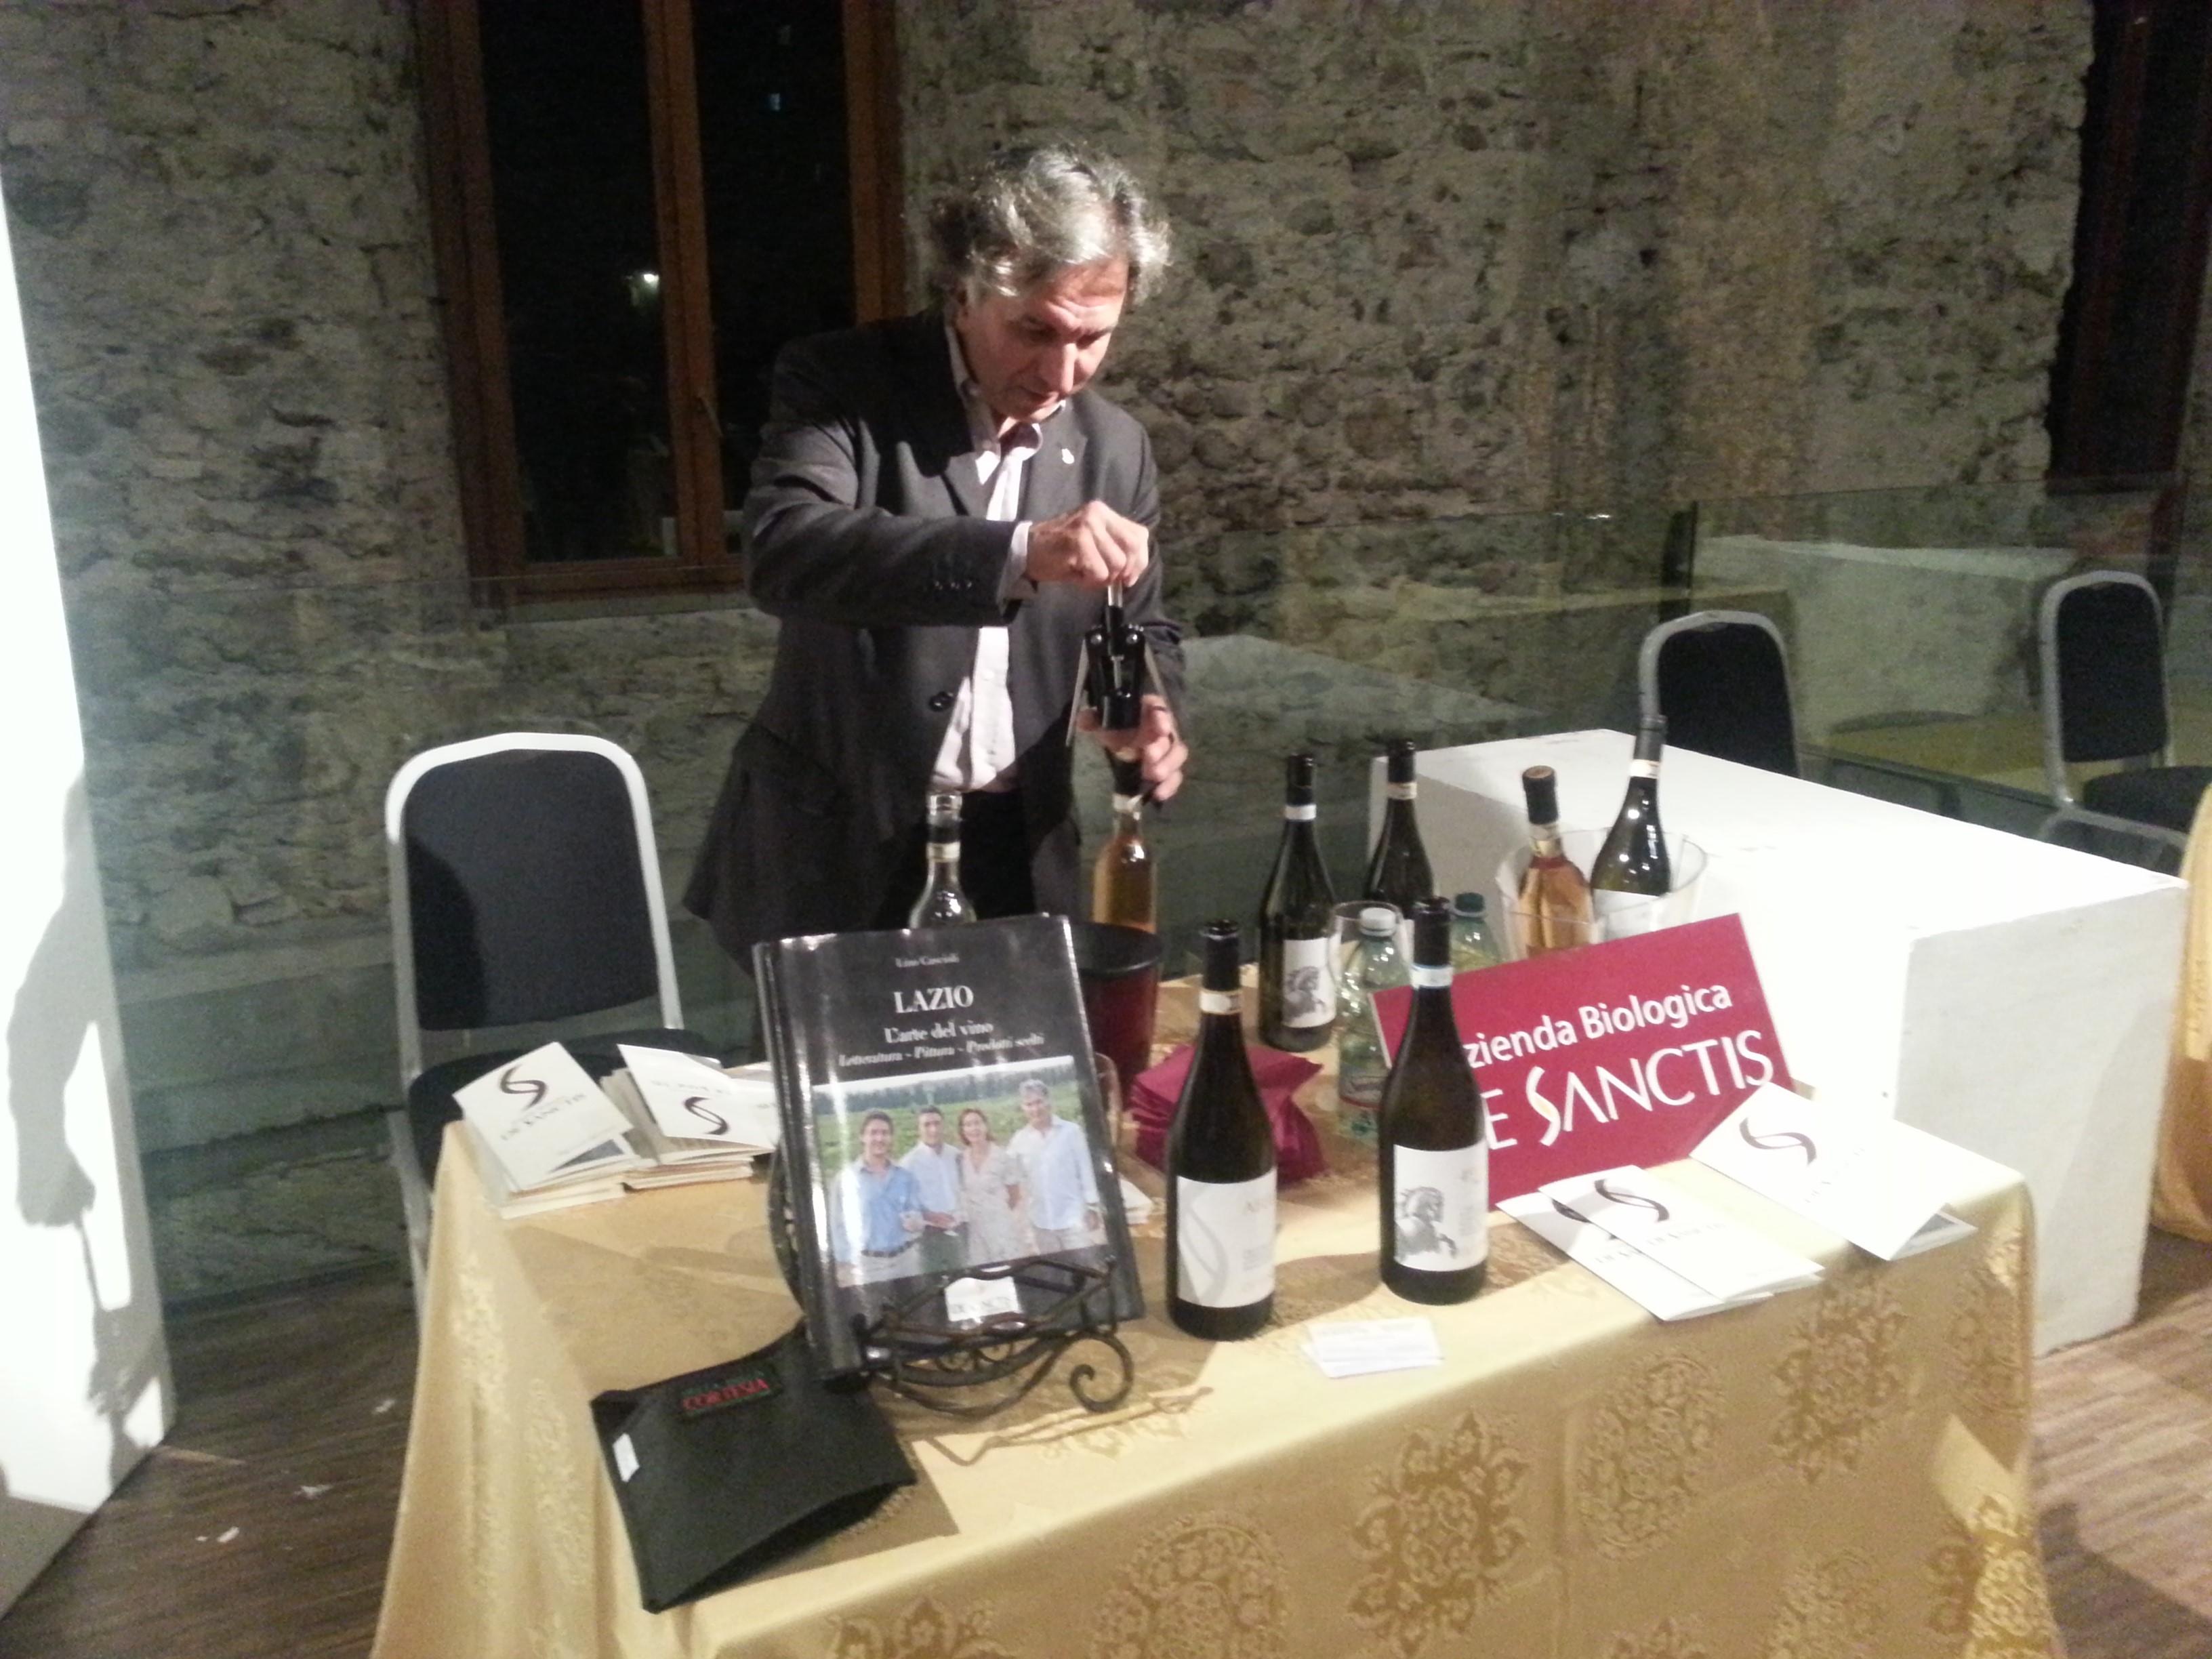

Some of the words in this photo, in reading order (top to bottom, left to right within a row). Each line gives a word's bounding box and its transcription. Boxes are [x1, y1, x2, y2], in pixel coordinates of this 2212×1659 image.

[893, 985, 974, 1014] LAZIO
[1462, 1015, 1578, 1069] zienda
[1578, 984, 1733, 1040] Biologica
[930, 1019, 956, 1039] del
[960, 1019, 994, 1036] vino
[1480, 1088, 1518, 1150] E
[1526, 1029, 1774, 1147] SANCTIS
